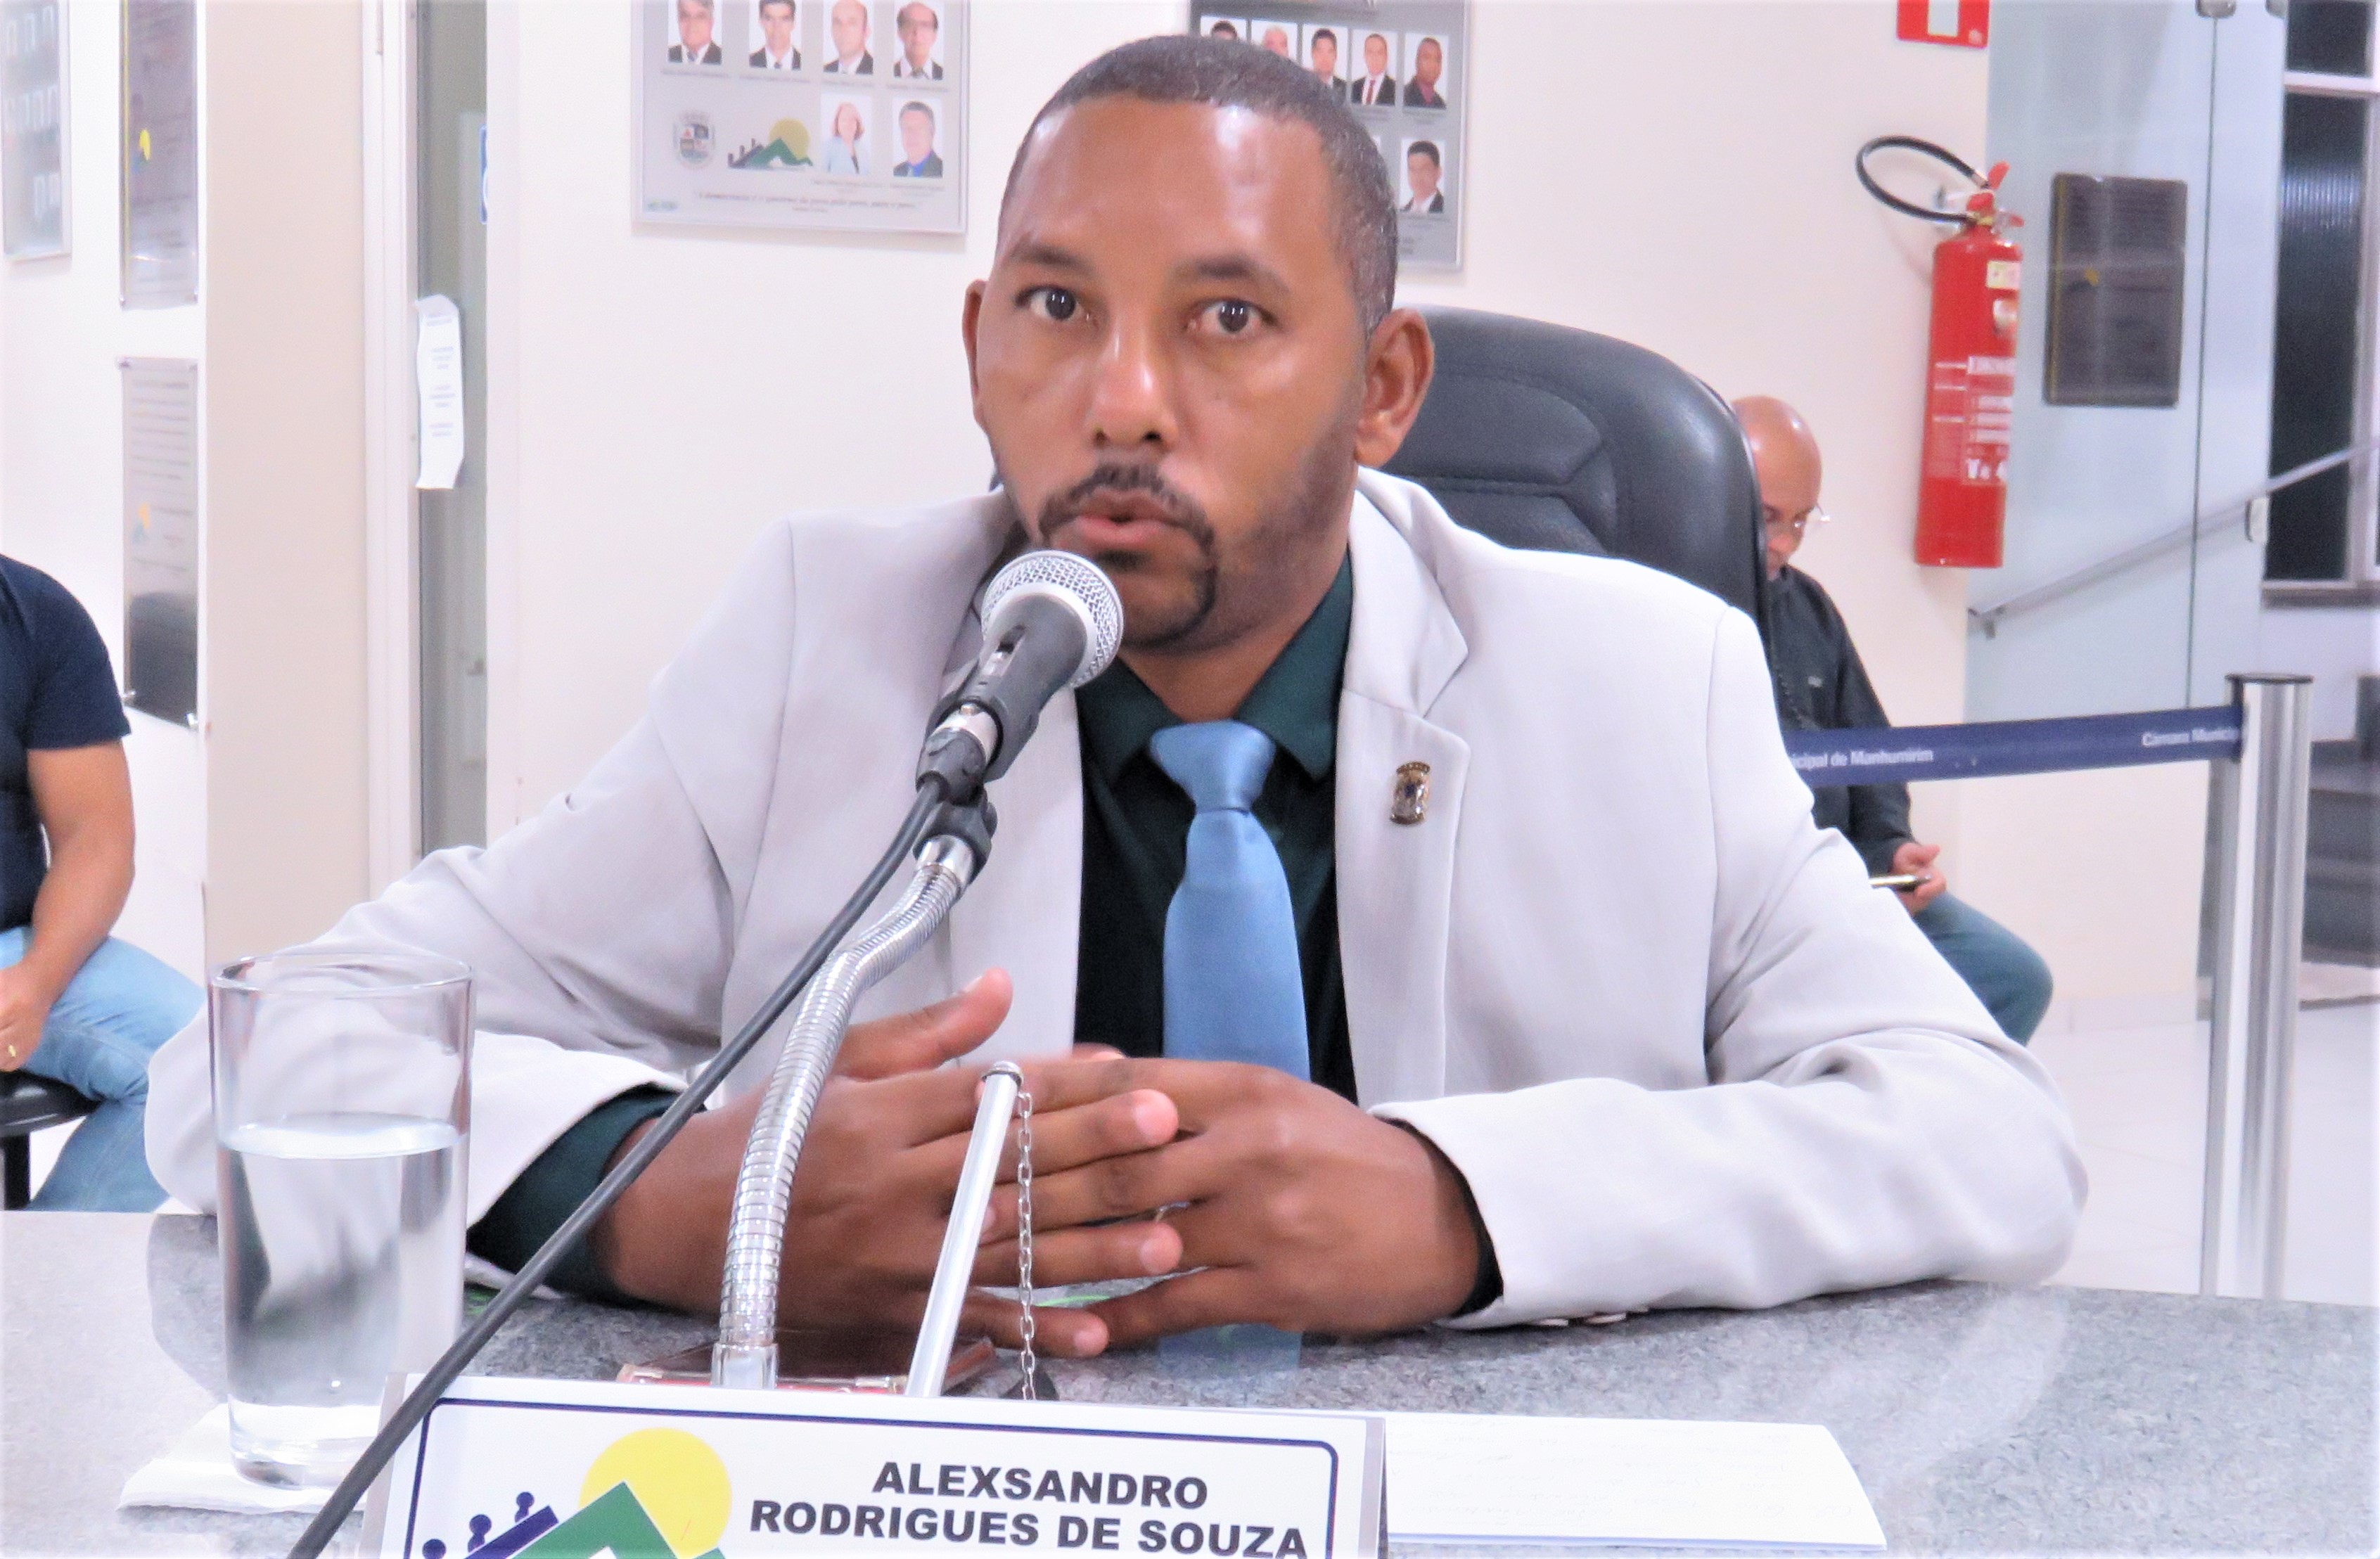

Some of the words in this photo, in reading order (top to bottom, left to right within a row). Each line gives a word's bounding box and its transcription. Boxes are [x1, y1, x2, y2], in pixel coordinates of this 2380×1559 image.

[1831, 752, 1848, 766] de
[871, 1461, 1208, 1509] ALEXSANDRO
[750, 1499, 1039, 1546] RODRIGUES
[1057, 1515, 1121, 1551] DE
[1137, 1520, 1307, 1559] SOUZA
